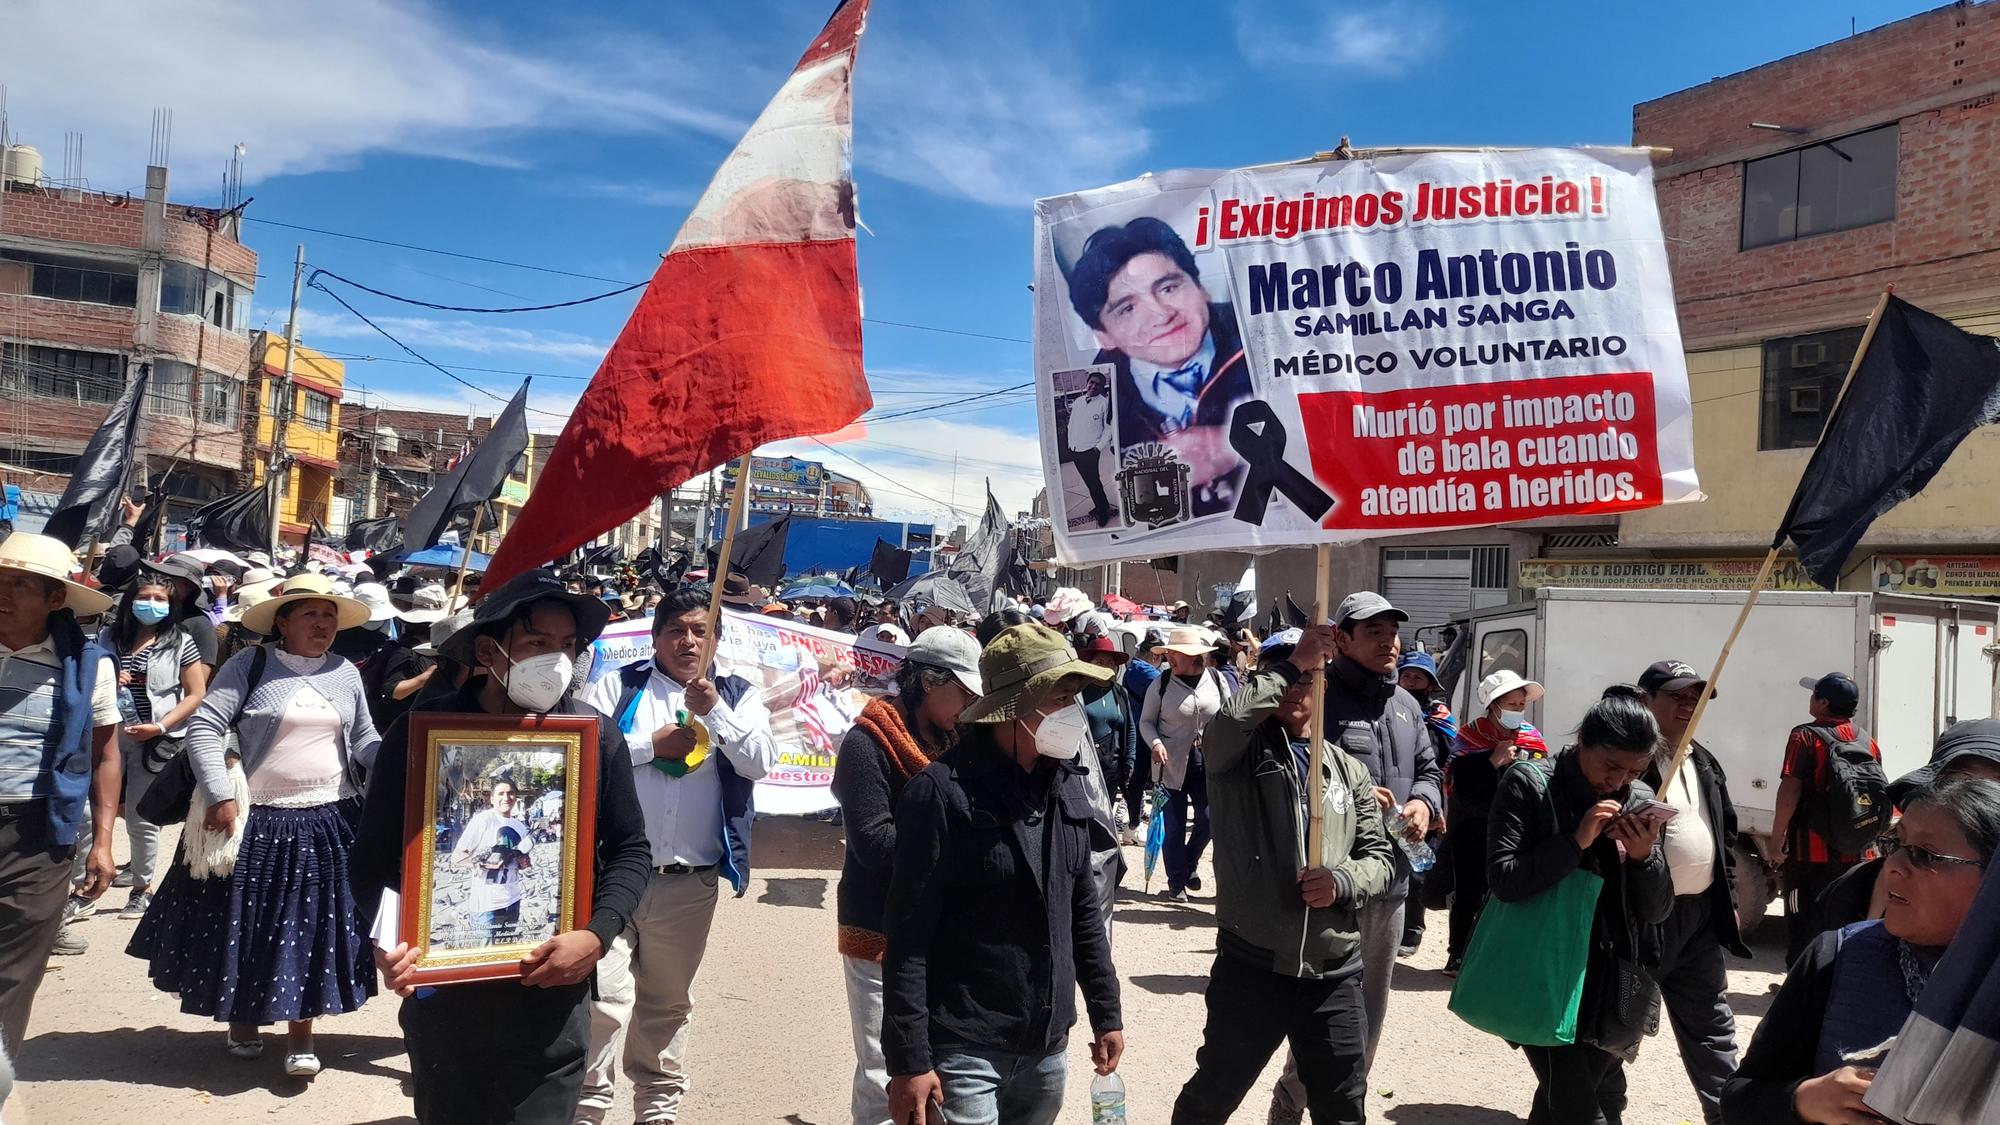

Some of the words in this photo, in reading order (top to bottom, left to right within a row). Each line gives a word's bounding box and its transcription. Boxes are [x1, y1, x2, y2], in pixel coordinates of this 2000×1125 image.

[1219, 191, 1404, 240] Exigimos
[1412, 176, 1579, 222] Justicia
[1248, 260, 1403, 316] Marco
[1415, 241, 1617, 301] Antonio
[1294, 307, 1447, 337] SAMILLAN
[1457, 299, 1575, 327] SANGA
[1273, 349, 1398, 377] MÉDICO
[1408, 335, 1628, 370] VOLUNTARIO
[1352, 400, 1437, 438] Murió
[1443, 401, 1495, 436] por
[1502, 389, 1635, 429] impacto
[1397, 441, 1435, 476] de
[1441, 436, 1510, 473] bala
[1517, 426, 1638, 467] cuando
[1360, 476, 1477, 516] atendía
[1483, 480, 1502, 510] a
[1508, 469, 1643, 509] heridos.
[1603, 564, 1665, 576] RODRIGO
